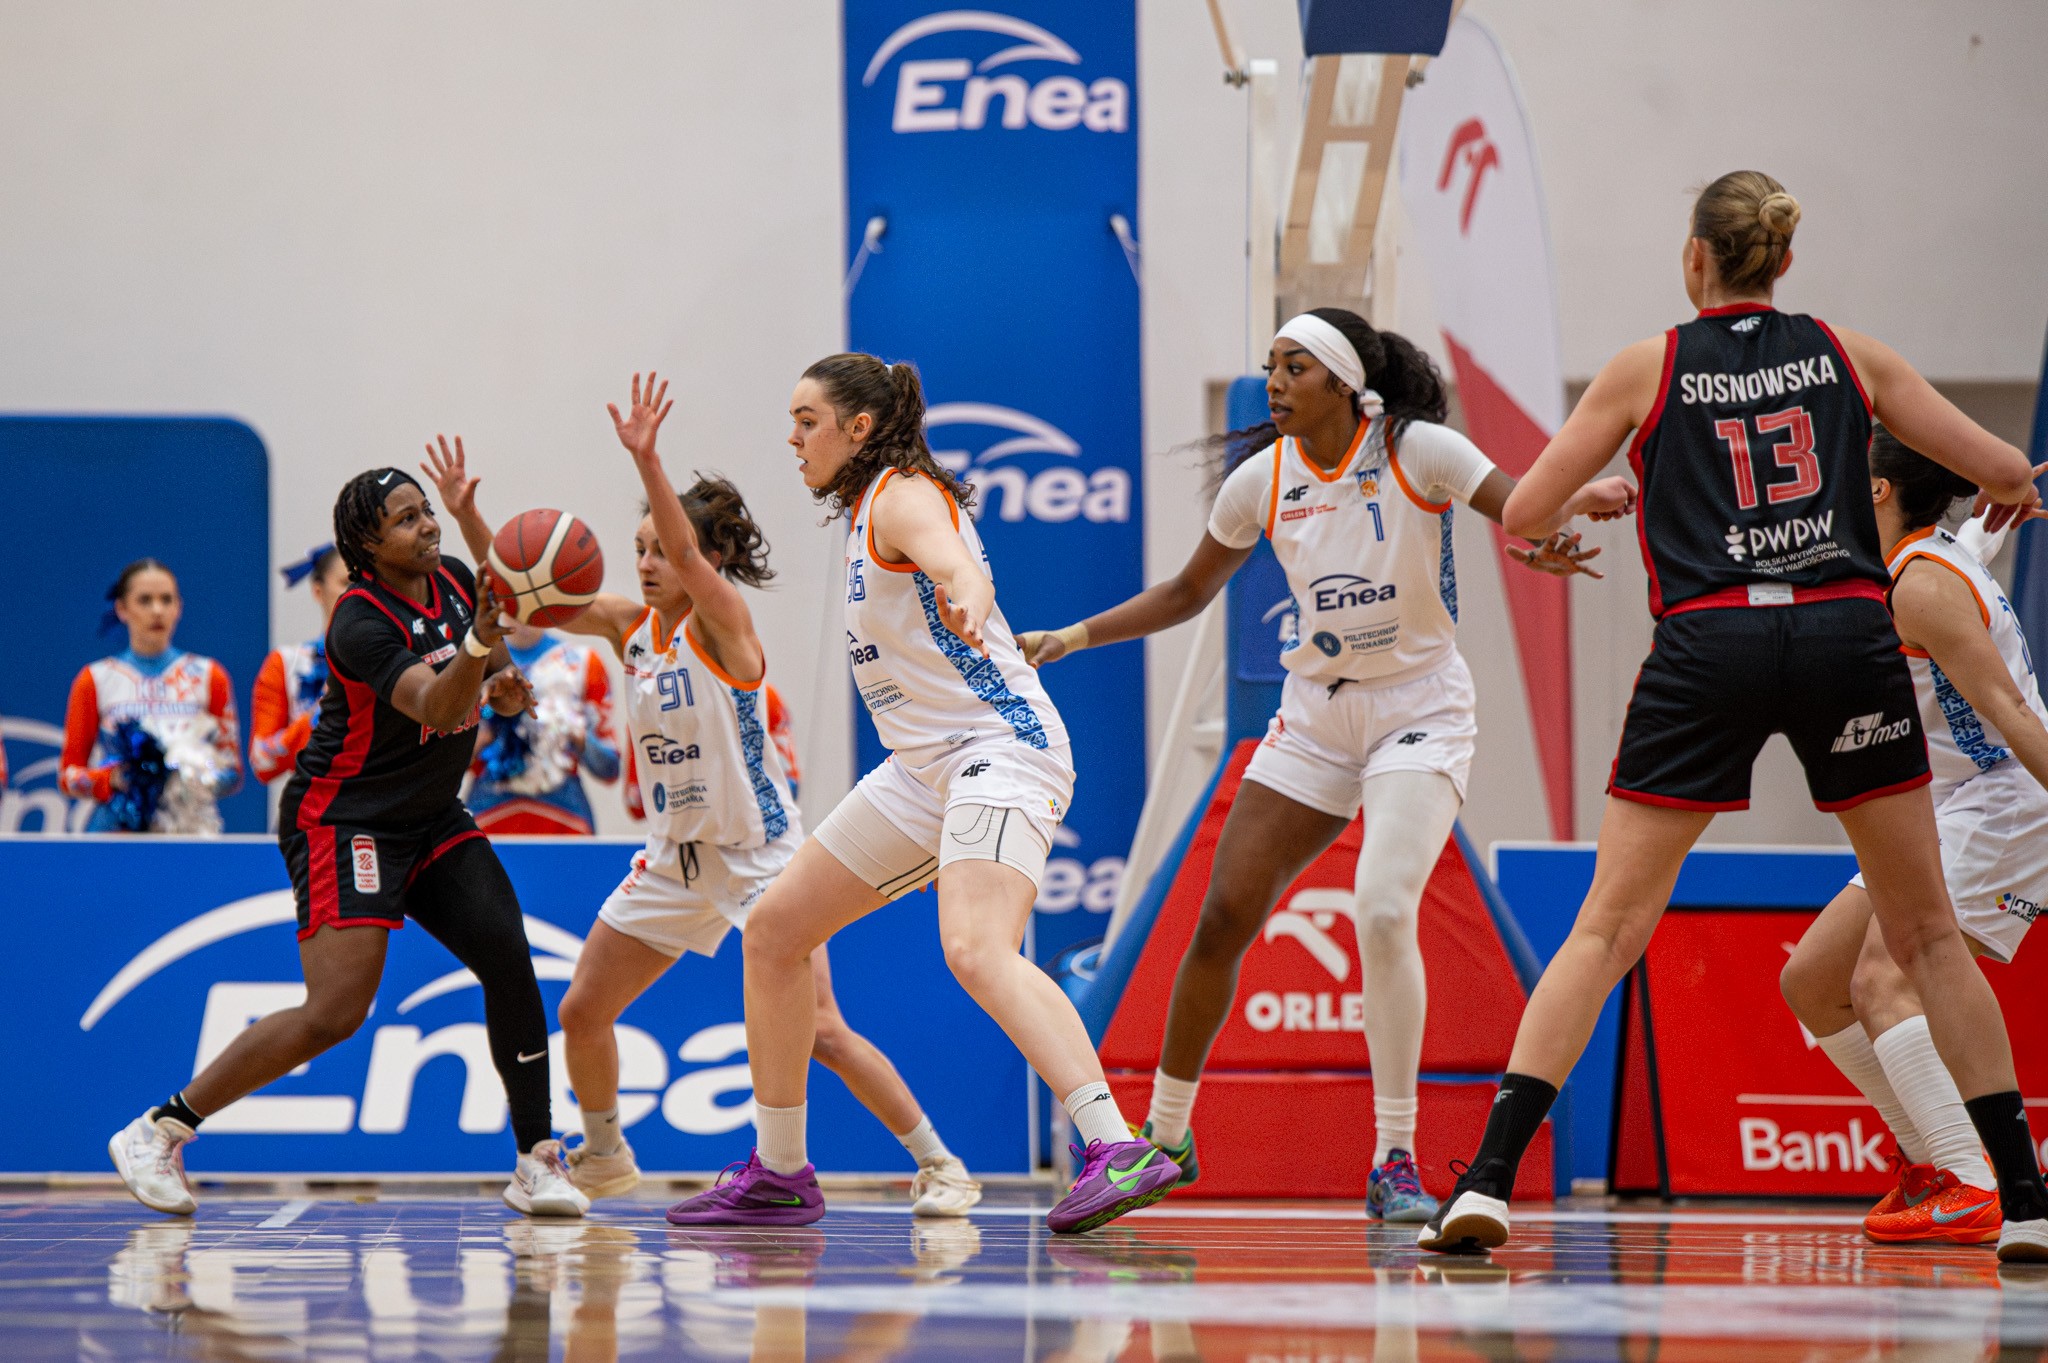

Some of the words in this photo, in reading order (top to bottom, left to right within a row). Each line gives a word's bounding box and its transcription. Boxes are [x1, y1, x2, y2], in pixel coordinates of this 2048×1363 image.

[892, 58, 1130, 133] Enea
[1680, 354, 1838, 405] SOSNOWSKA
[1714, 406, 1821, 509] 13
[932, 449, 1131, 523] nea
[1284, 484, 1309, 501] 4F
[1366, 503, 1384, 541] 1
[1749, 509, 1833, 557] PWPW
[1755, 556, 1788, 568] POLSKA
[1788, 541, 1838, 561] WYTWÓRNIA
[1316, 584, 1396, 612] Enea
[850, 645, 880, 666] nea
[656, 668, 694, 712] 91
[1397, 732, 1427, 745] 4F
[1872, 717, 1911, 746] mza
[961, 763, 992, 778] 4F
[1244, 991, 1366, 1032] ORLE
[1739, 1117, 1889, 1172] Bank
